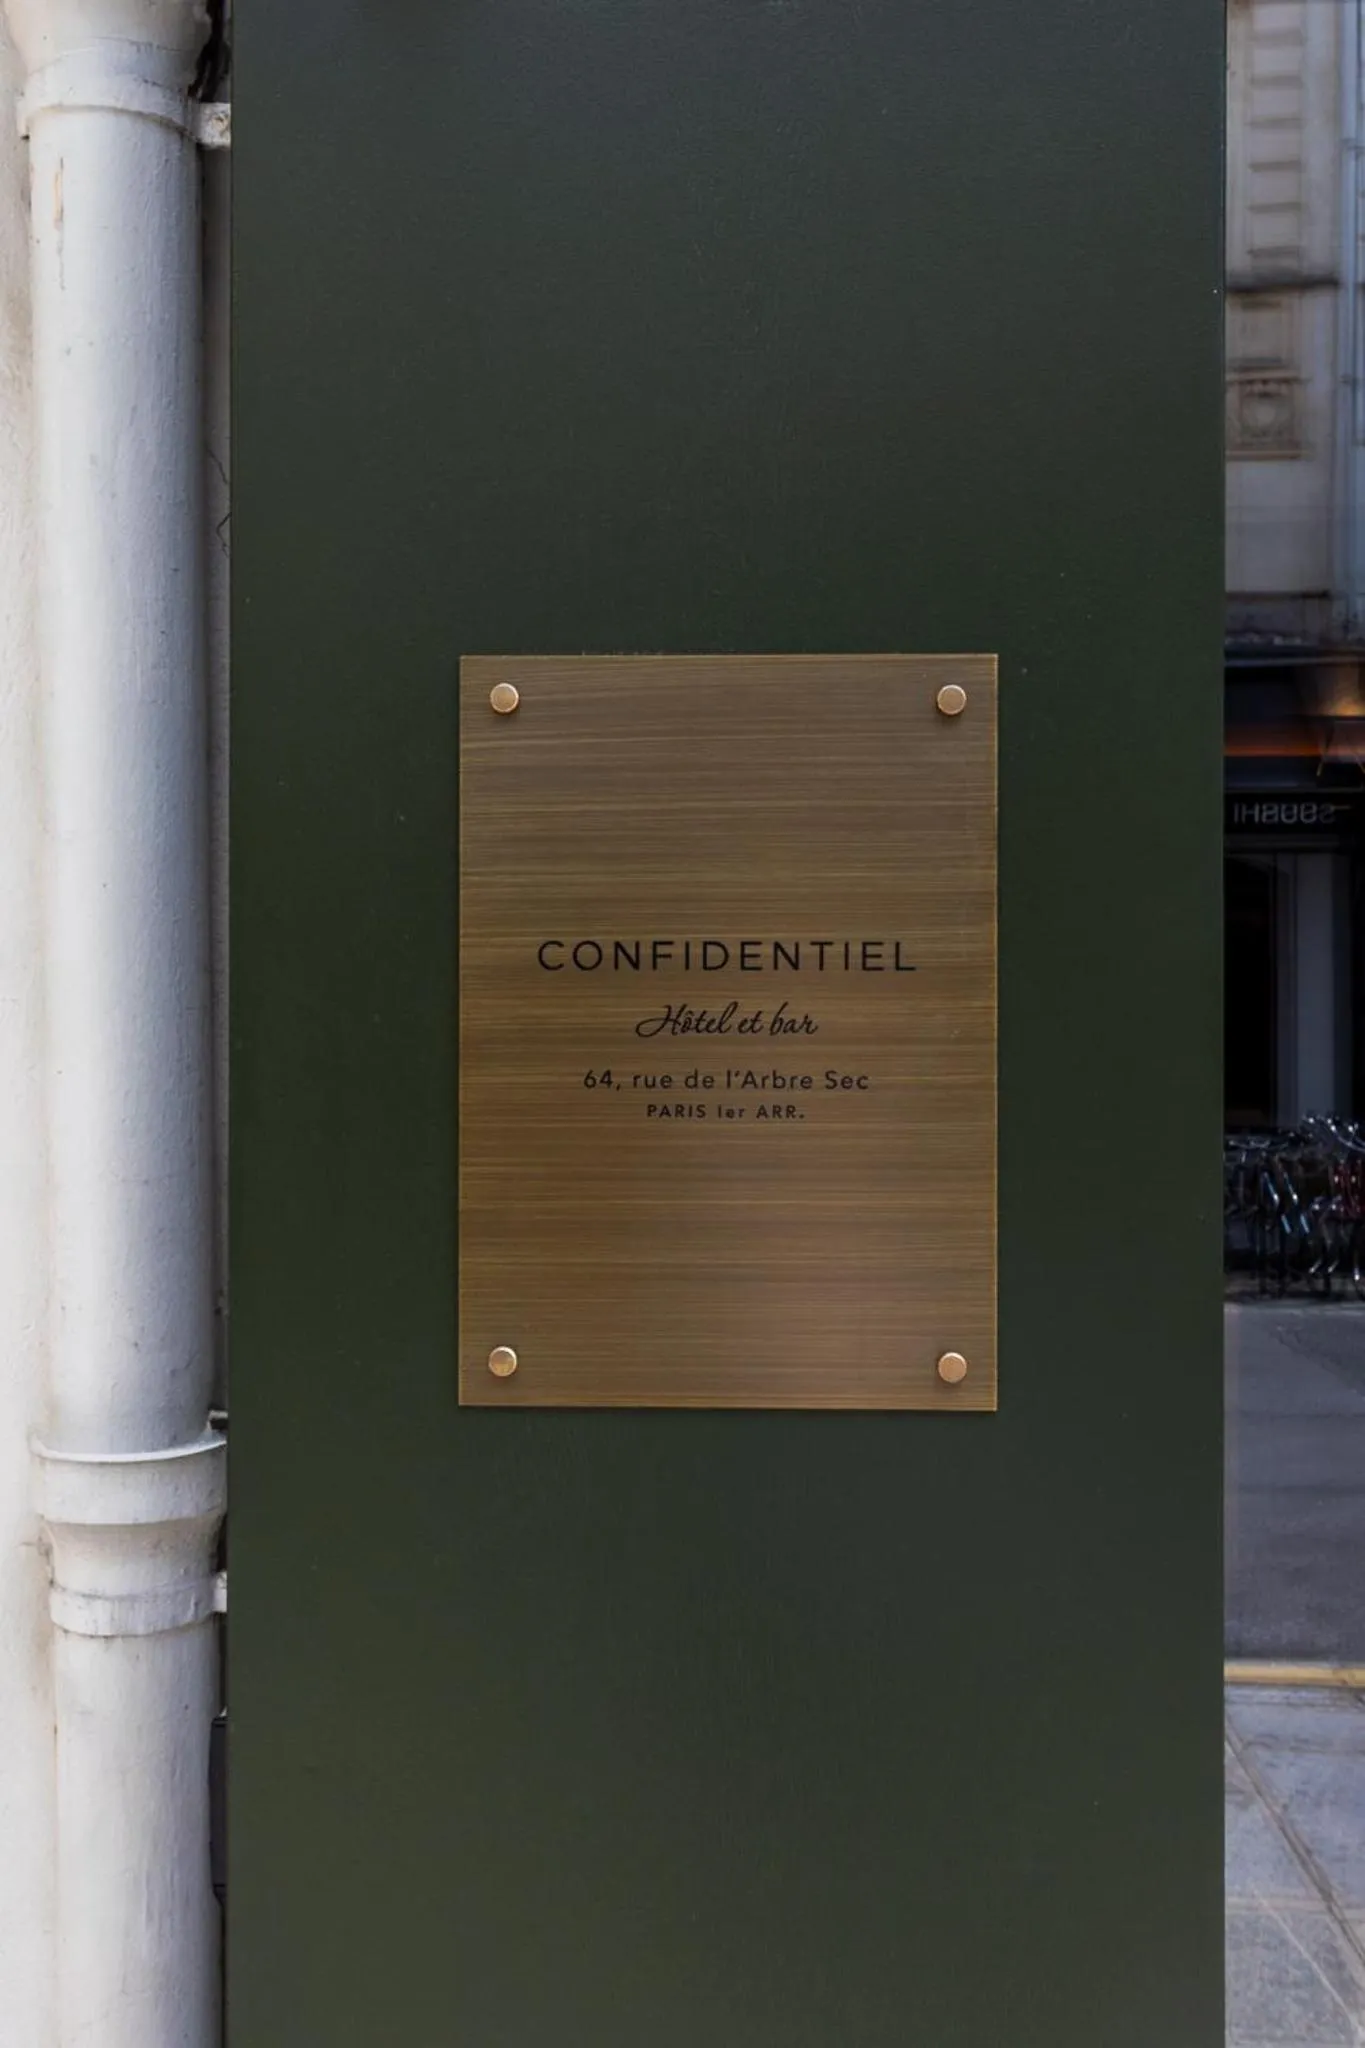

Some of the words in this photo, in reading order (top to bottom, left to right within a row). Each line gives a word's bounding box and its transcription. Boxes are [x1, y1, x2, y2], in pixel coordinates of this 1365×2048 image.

[538, 939, 917, 972] CONFIDENTIEL
[635, 1001, 739, 1038] Hôtel
[737, 1010, 765, 1034] et
[770, 1001, 818, 1037] bar
[583, 1069, 621, 1091] 64,
[633, 1075, 673, 1089] rue
[685, 1069, 715, 1089] de
[726, 1069, 813, 1090] l'Arbre
[824, 1069, 869, 1090] Sec
[646, 1103, 706, 1119] PARIS
[755, 1104, 805, 1119] ARR.
